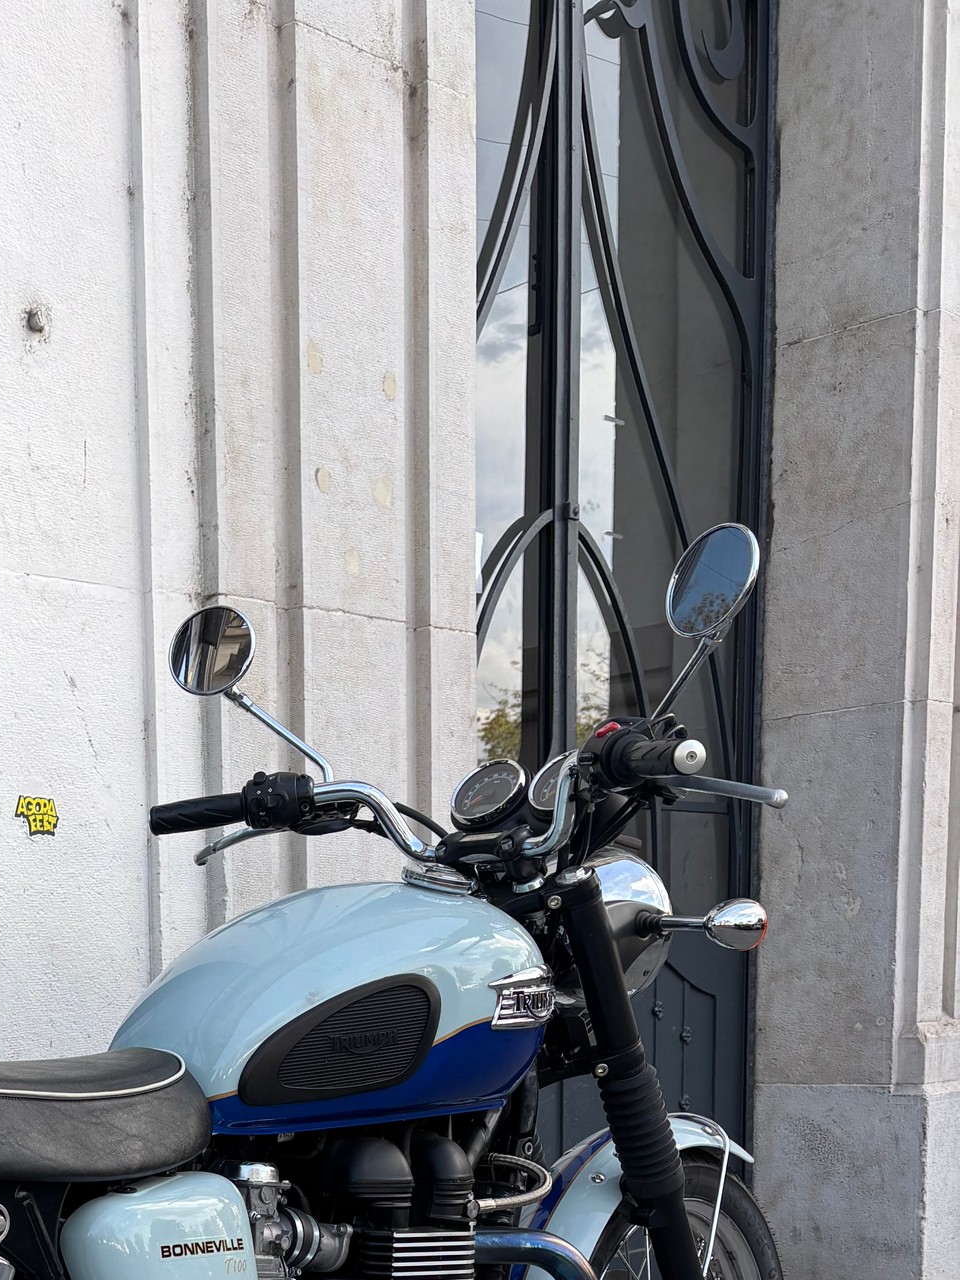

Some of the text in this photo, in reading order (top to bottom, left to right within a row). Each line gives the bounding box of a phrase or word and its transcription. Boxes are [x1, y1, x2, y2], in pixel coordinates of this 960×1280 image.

[15, 795, 57, 817] AGORA
[328, 1029, 398, 1055] TRIUMPH
[160, 1238, 245, 1259] BONNEVILLE
[224, 1257, 248, 1275] T100
